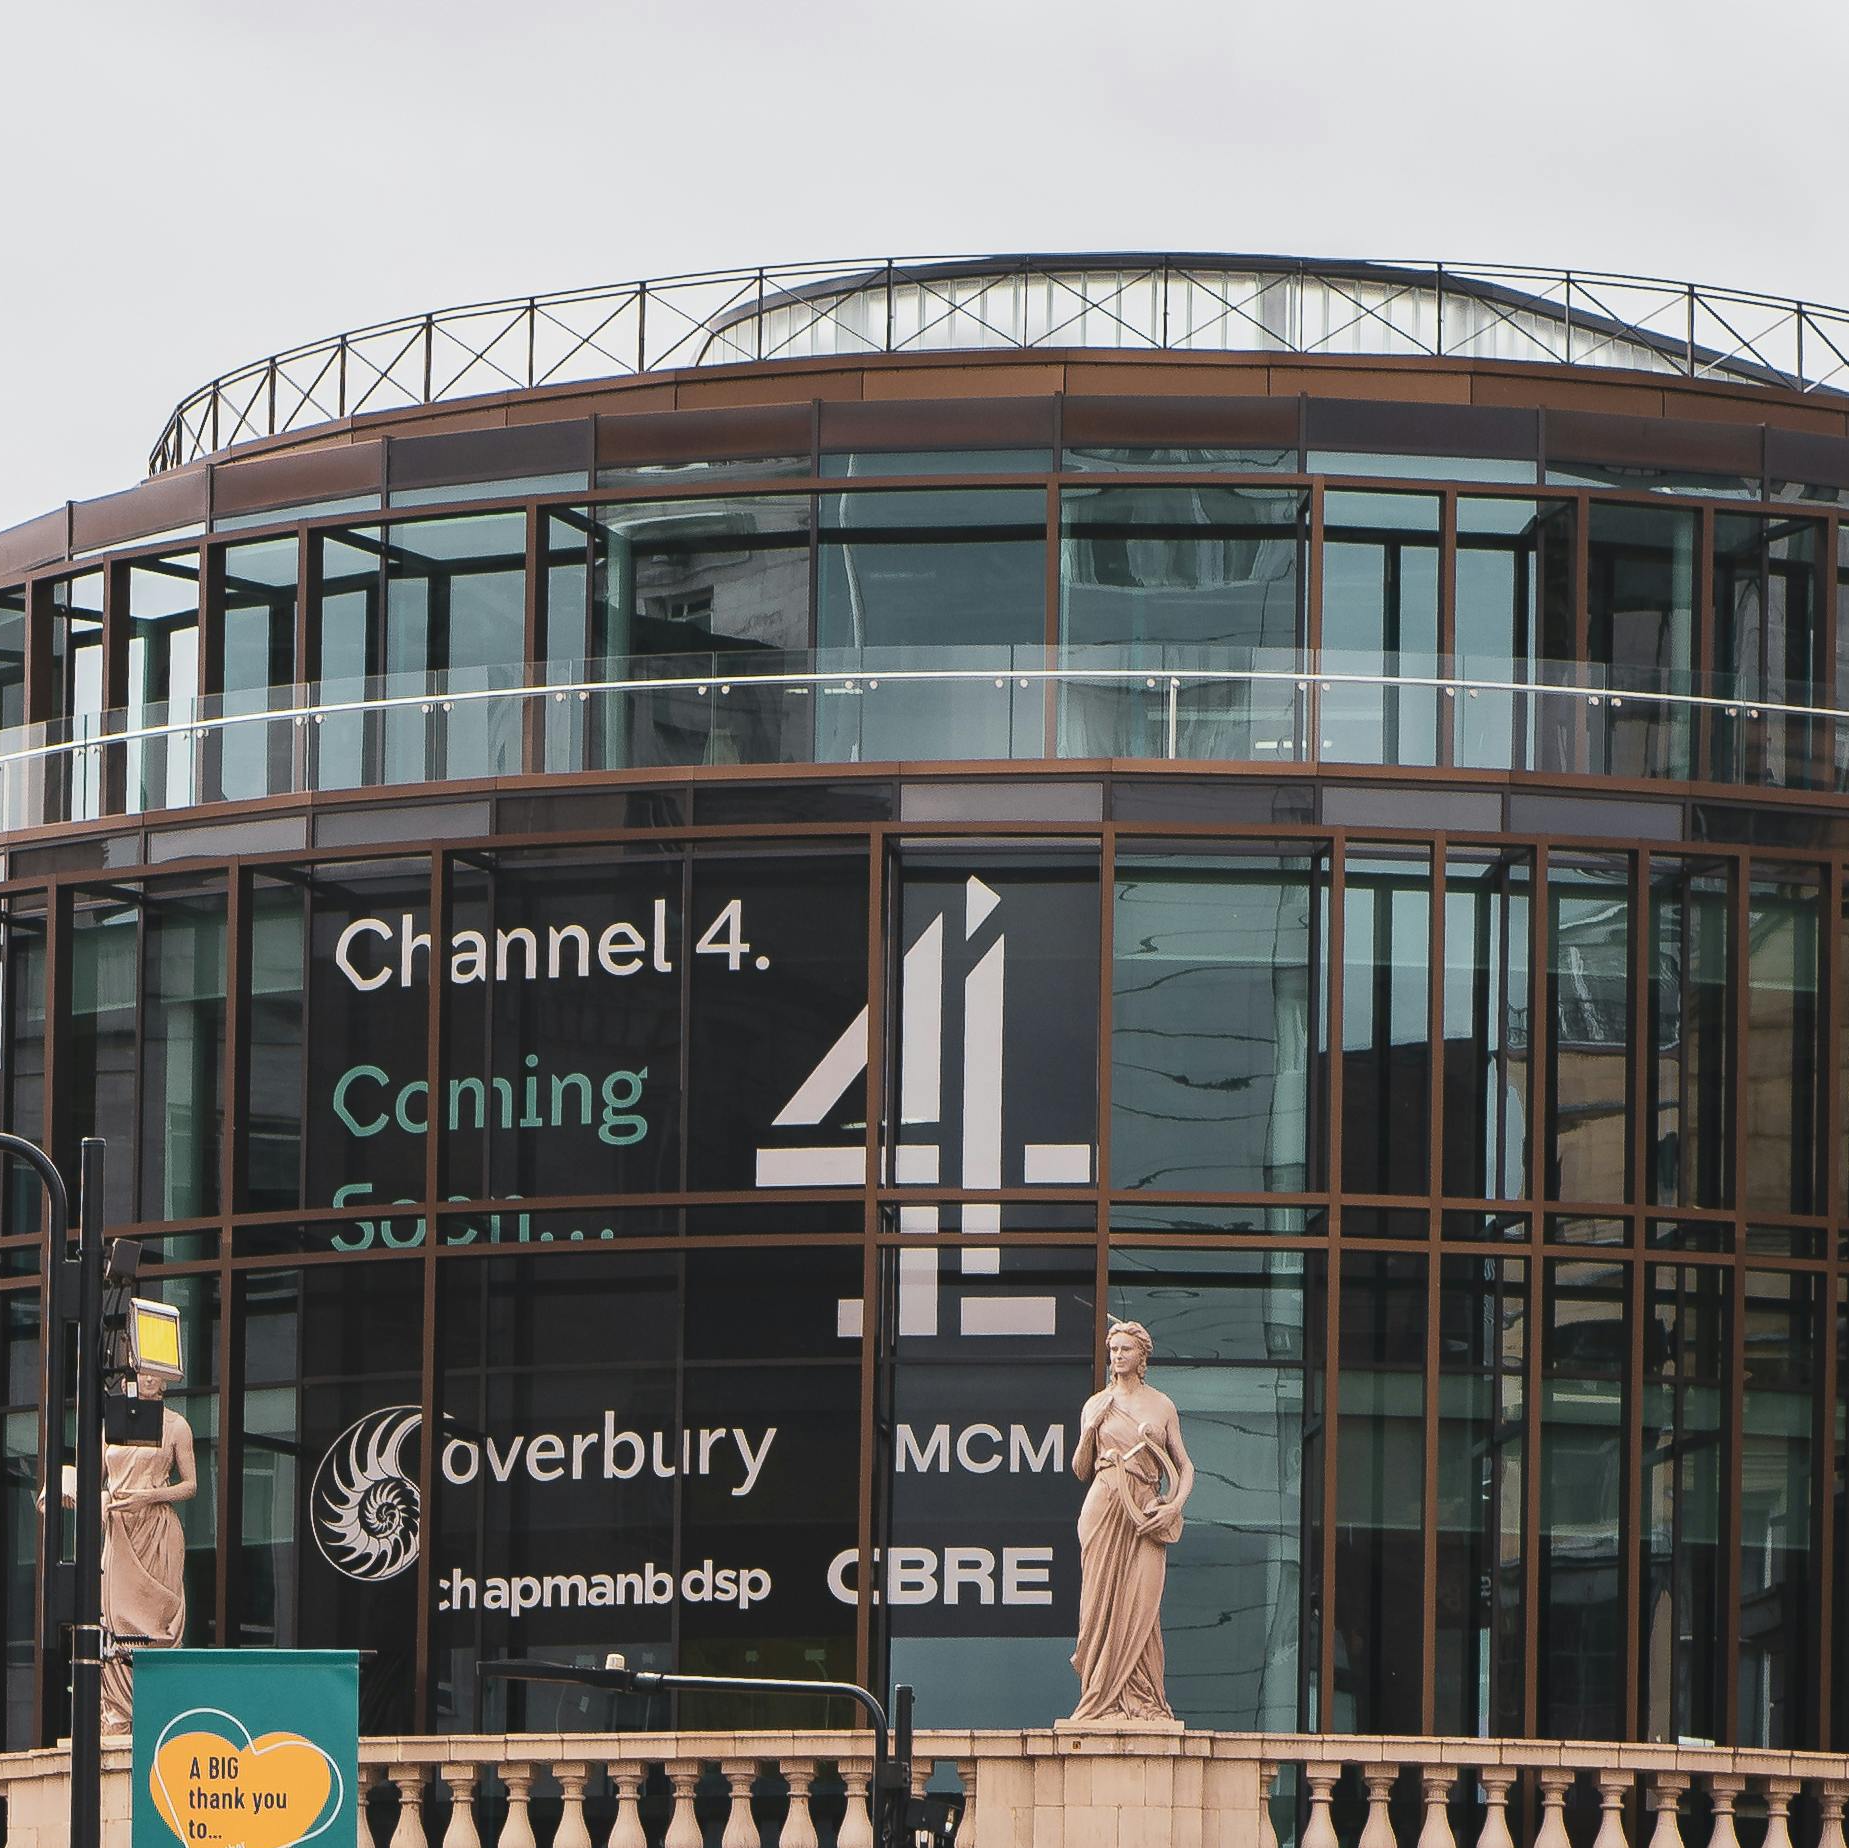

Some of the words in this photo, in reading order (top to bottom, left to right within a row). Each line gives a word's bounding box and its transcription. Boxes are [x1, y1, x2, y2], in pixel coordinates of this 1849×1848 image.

[335, 898, 673, 991] Channel
[695, 899, 770, 973] 4.
[333, 1053, 649, 1146] Coming
[441, 1411, 778, 1496] overbury
[895, 1423, 1064, 1474] MCM
[826, 1547, 1054, 1605] CBRE
[189, 1756, 201, 1780] A
[209, 1756, 239, 1780] BIG
[189, 1787, 245, 1810] thank
[252, 1792, 287, 1815] you
[189, 1820, 222, 1839] to...
